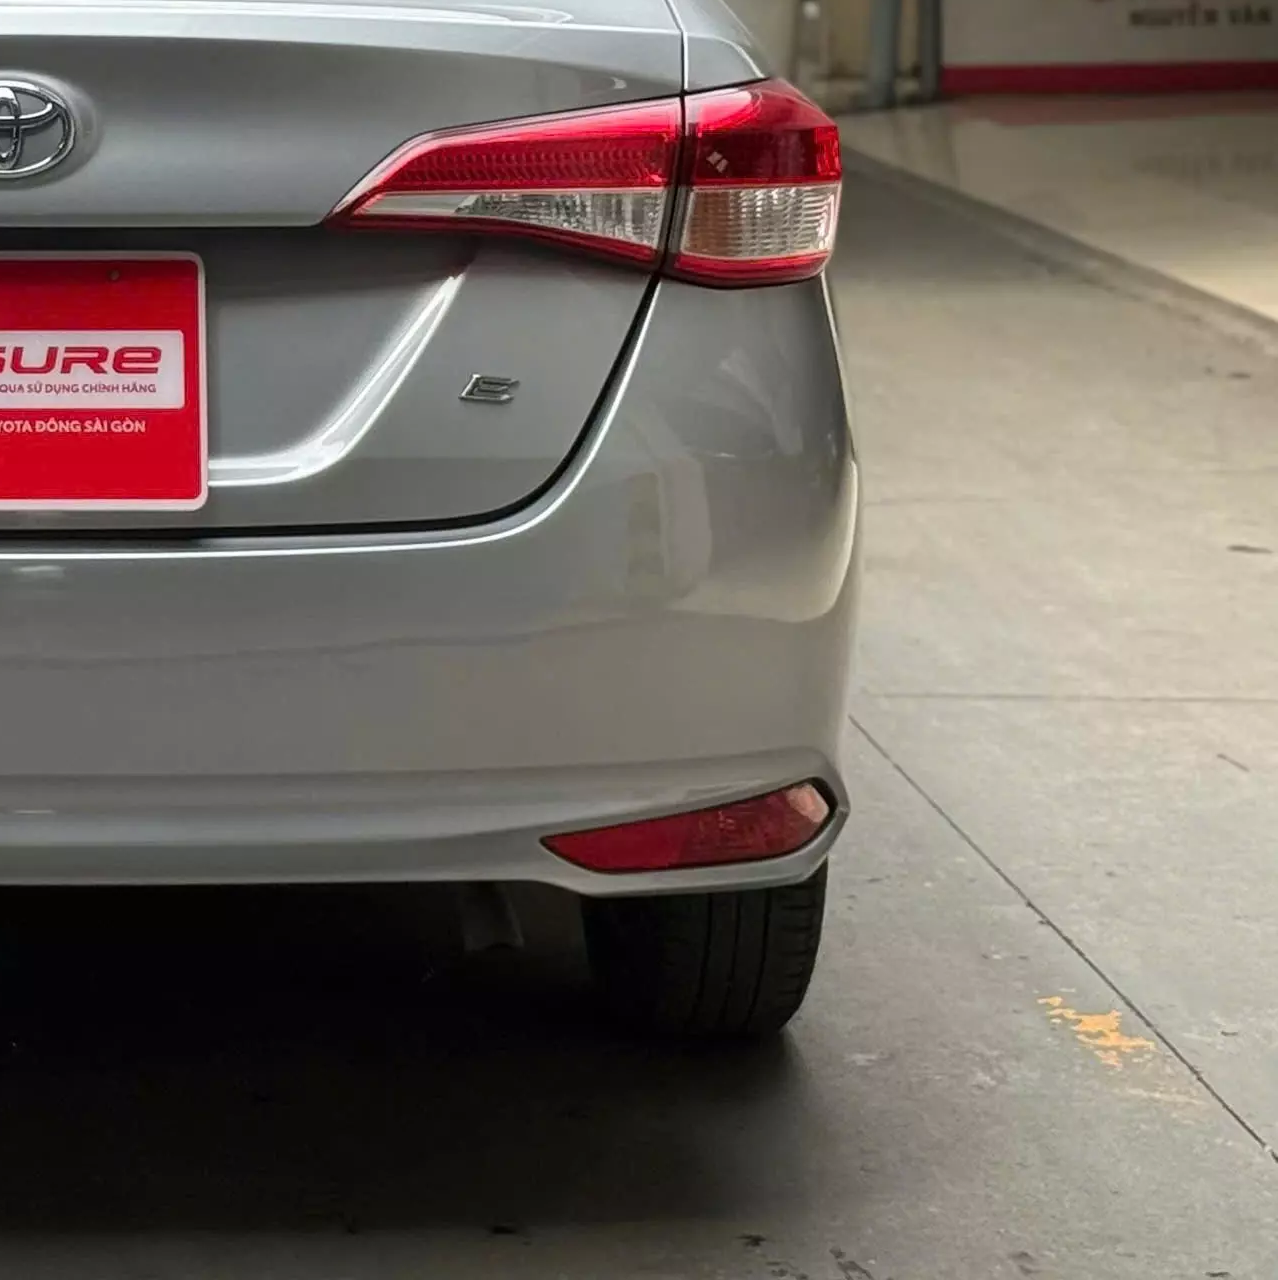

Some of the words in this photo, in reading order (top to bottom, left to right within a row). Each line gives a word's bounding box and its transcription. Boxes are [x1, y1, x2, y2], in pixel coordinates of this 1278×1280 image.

[0, 383, 25, 394] QUA
[45, 383, 79, 396] DỤNG
[458, 374, 520, 404] E
